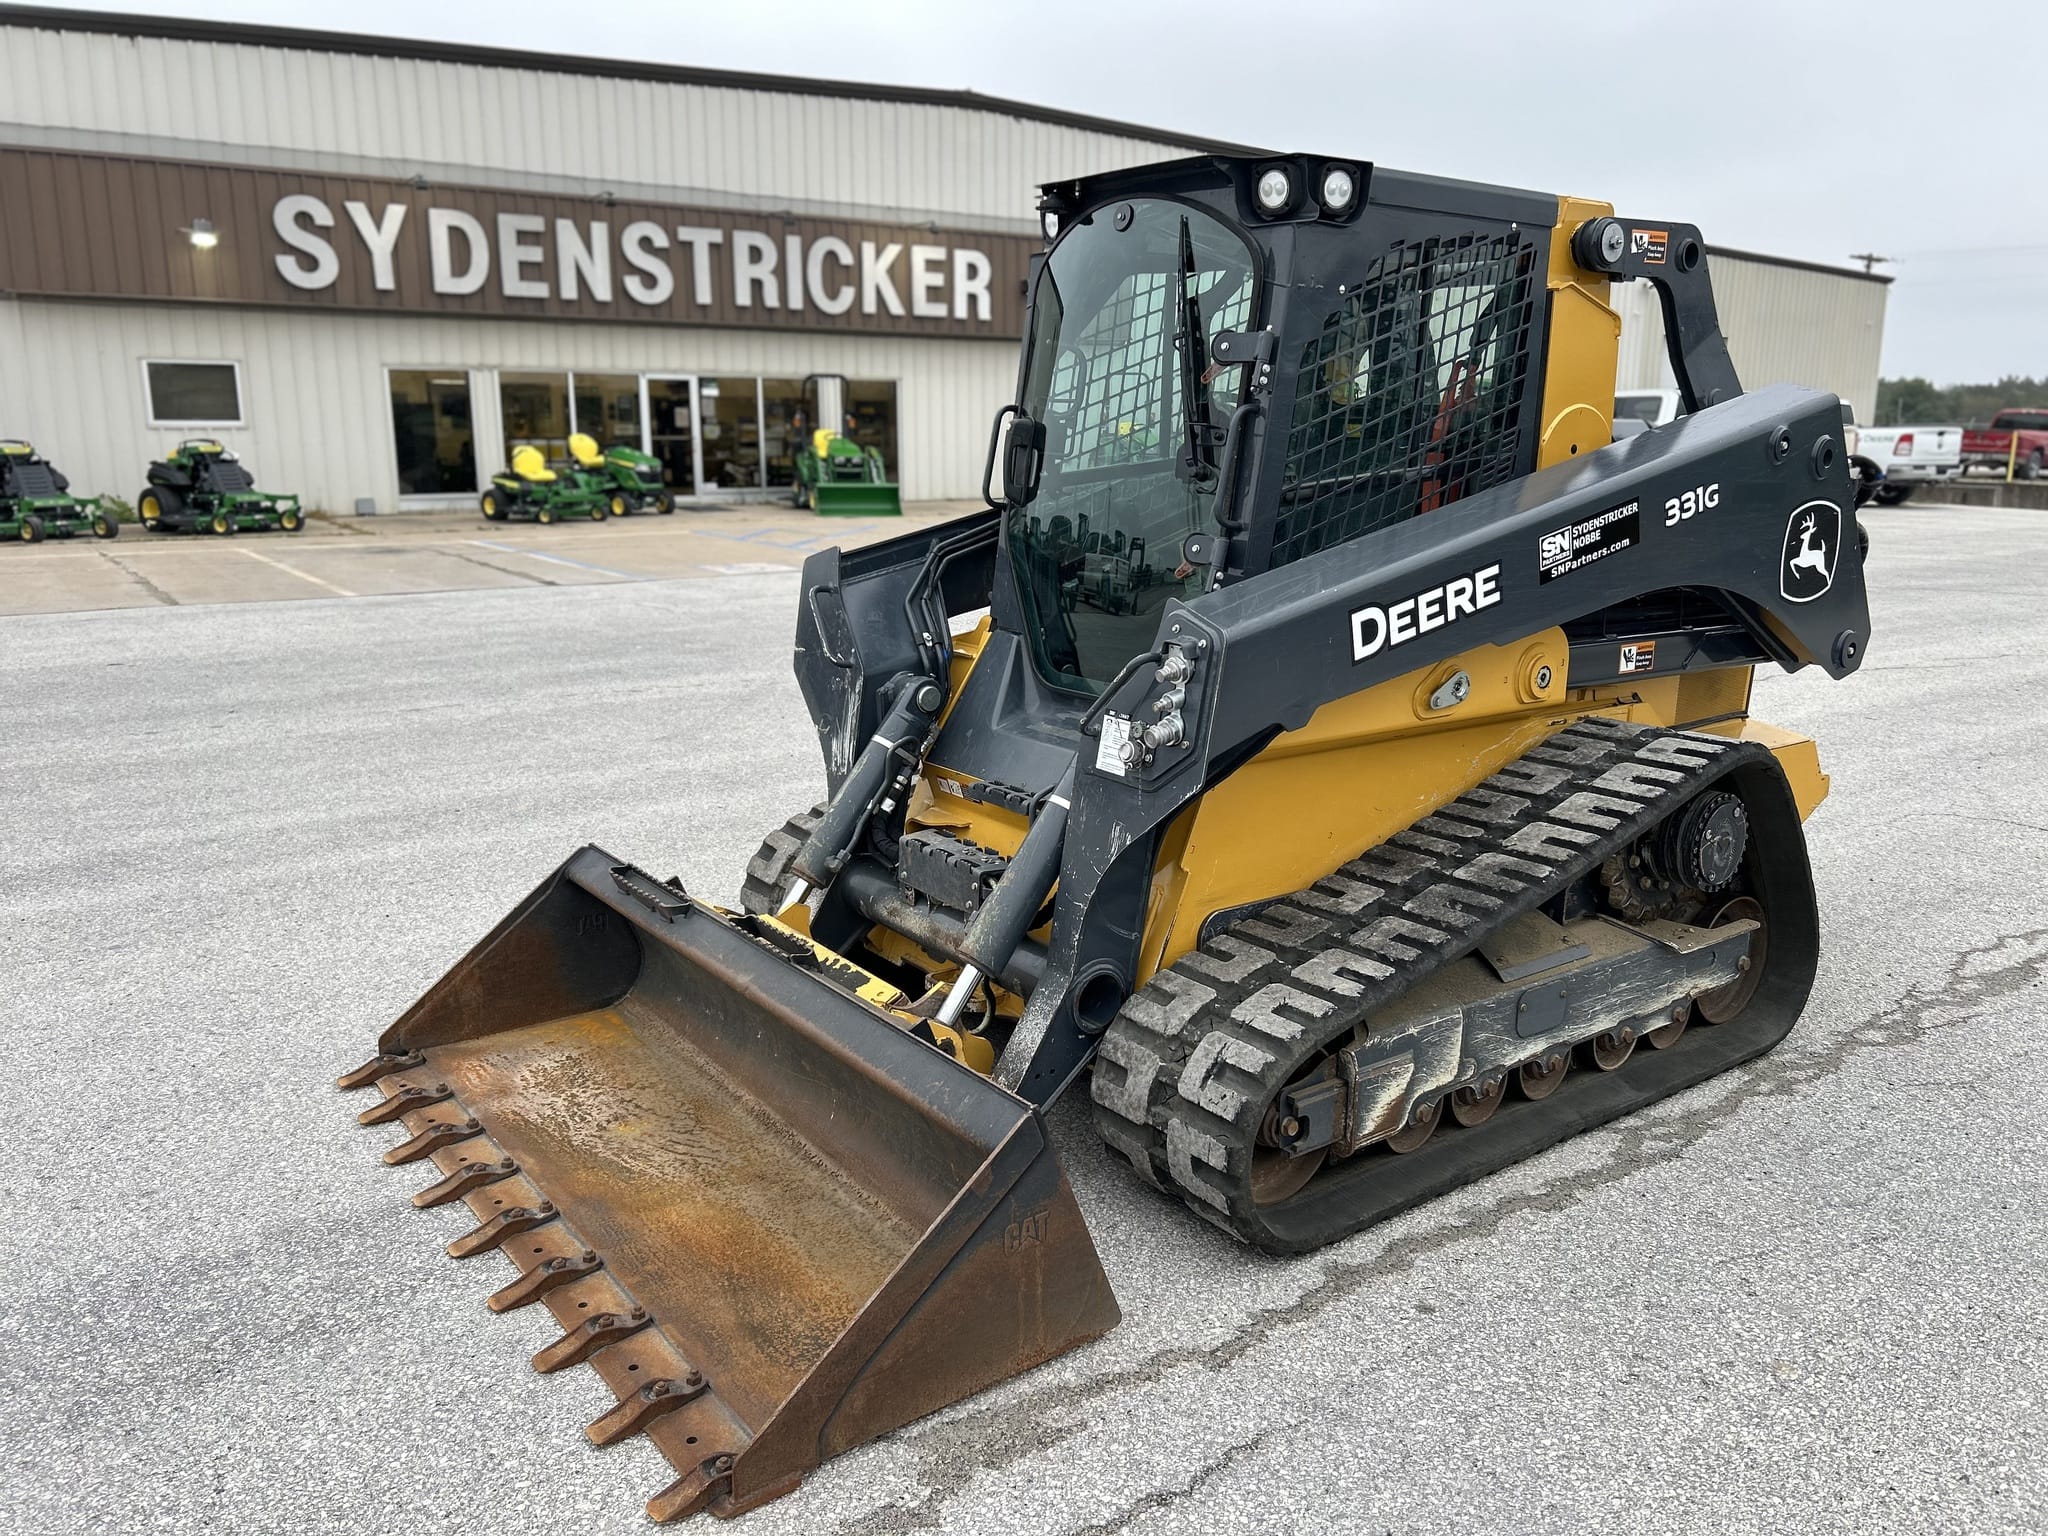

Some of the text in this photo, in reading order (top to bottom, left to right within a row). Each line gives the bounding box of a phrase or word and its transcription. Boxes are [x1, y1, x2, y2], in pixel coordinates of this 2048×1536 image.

[272, 194, 993, 321] SYDENSTRICKER
[1572, 502, 1639, 537] SYDENSTRICKER
[1665, 483, 1719, 526] 331G
[1542, 530, 1570, 558] SN
[1551, 538, 1630, 577] SNPartners.com
[1573, 529, 1601, 550] NOBBE
[1351, 564, 1500, 661] DEERE
[1004, 1210, 1049, 1257] CAT
